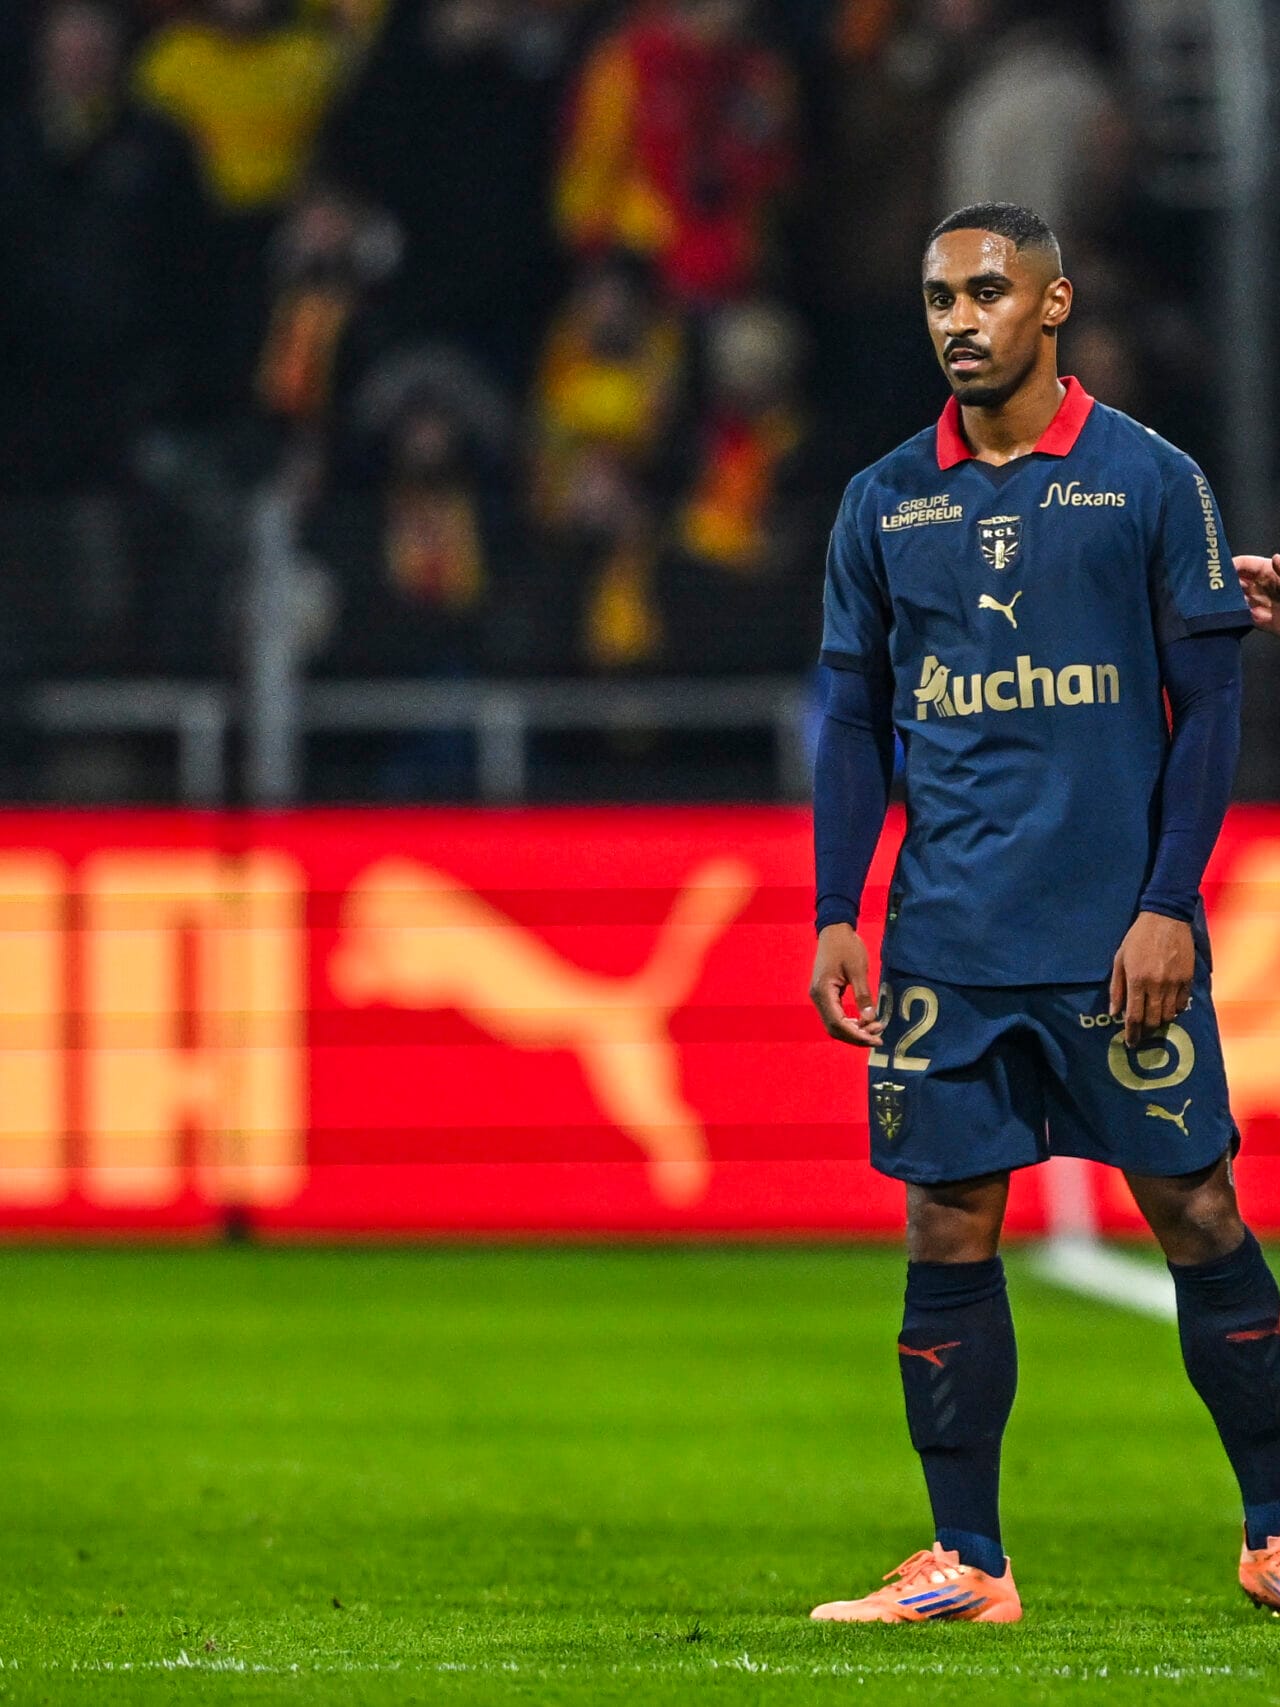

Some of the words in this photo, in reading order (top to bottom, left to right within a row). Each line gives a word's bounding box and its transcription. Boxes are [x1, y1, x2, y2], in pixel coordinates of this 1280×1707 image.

[898, 494, 950, 514] GROUPE
[1040, 481, 1126, 508] Nexans
[881, 505, 963, 529] LEMPEREUR
[982, 527, 1016, 538] RCL
[913, 655, 1120, 721] Auchan
[0, 848, 308, 1207] A
